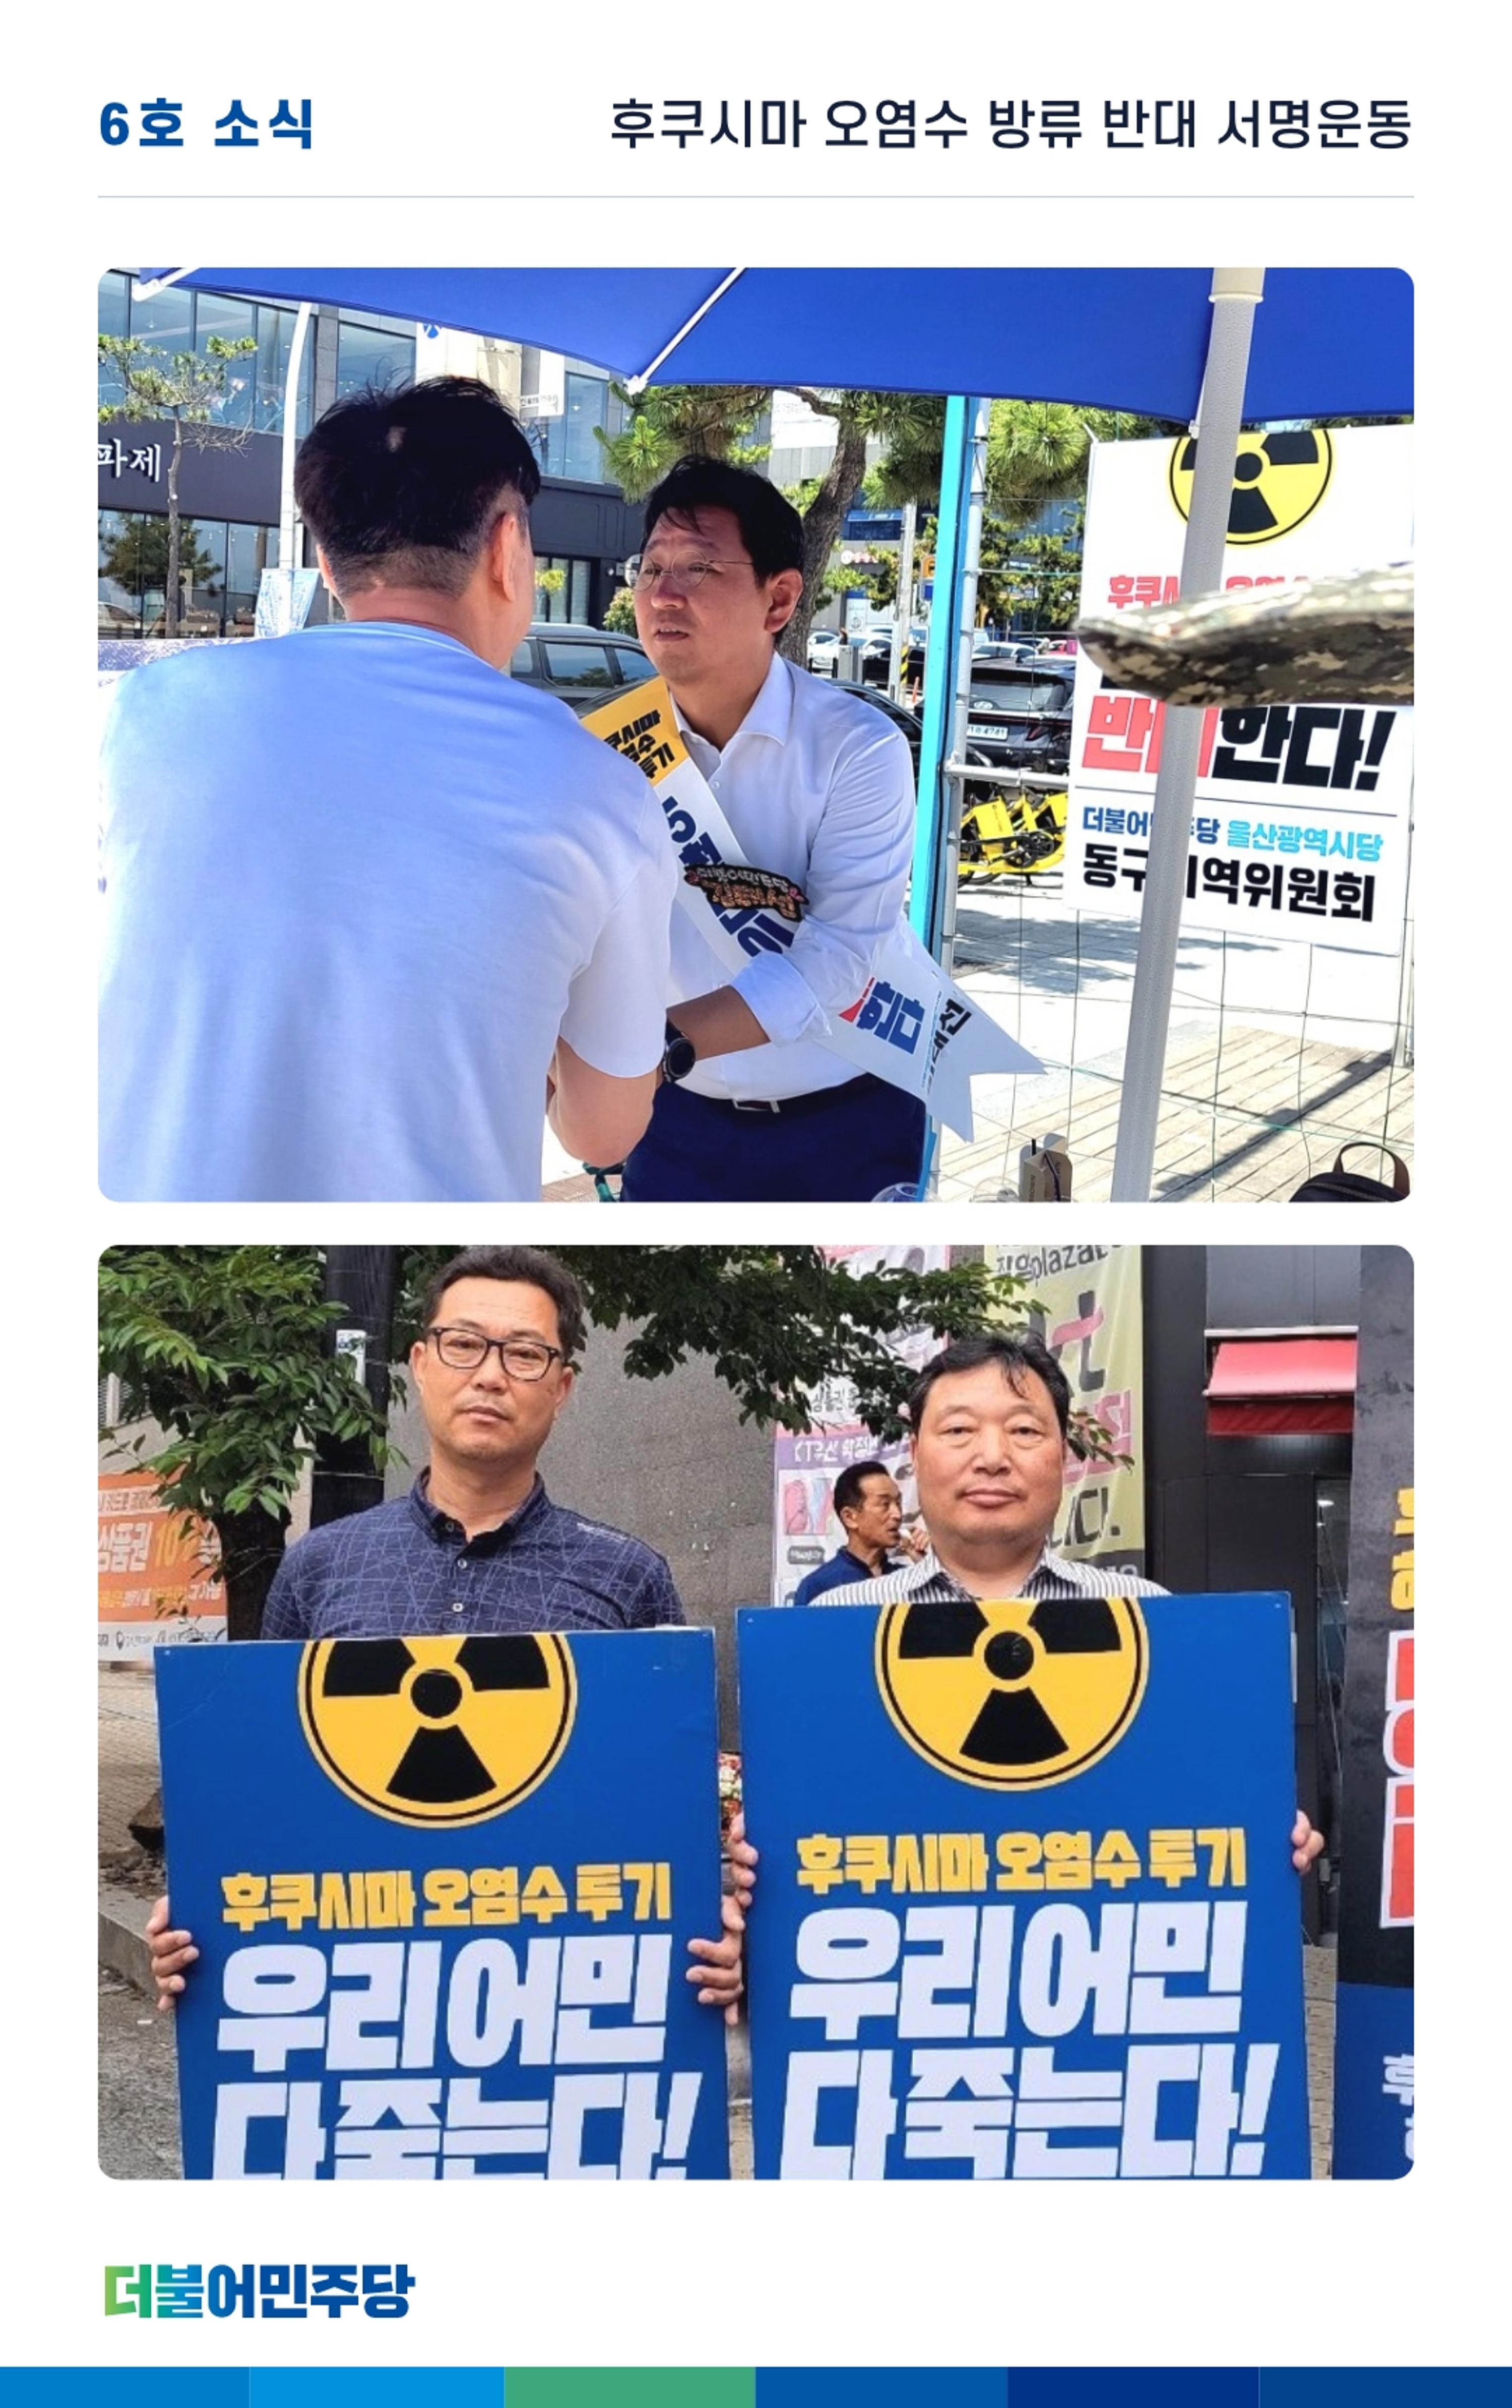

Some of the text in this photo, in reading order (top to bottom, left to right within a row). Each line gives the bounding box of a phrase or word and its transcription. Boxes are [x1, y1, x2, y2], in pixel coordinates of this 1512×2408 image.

[1082, 807, 1383, 862] 더불어당 울산광역시당
[797, 1828, 1246, 1894] 후쿠시마 오염수 투기
[221, 1863, 671, 1932] 후쿠시마 오염수 투기
